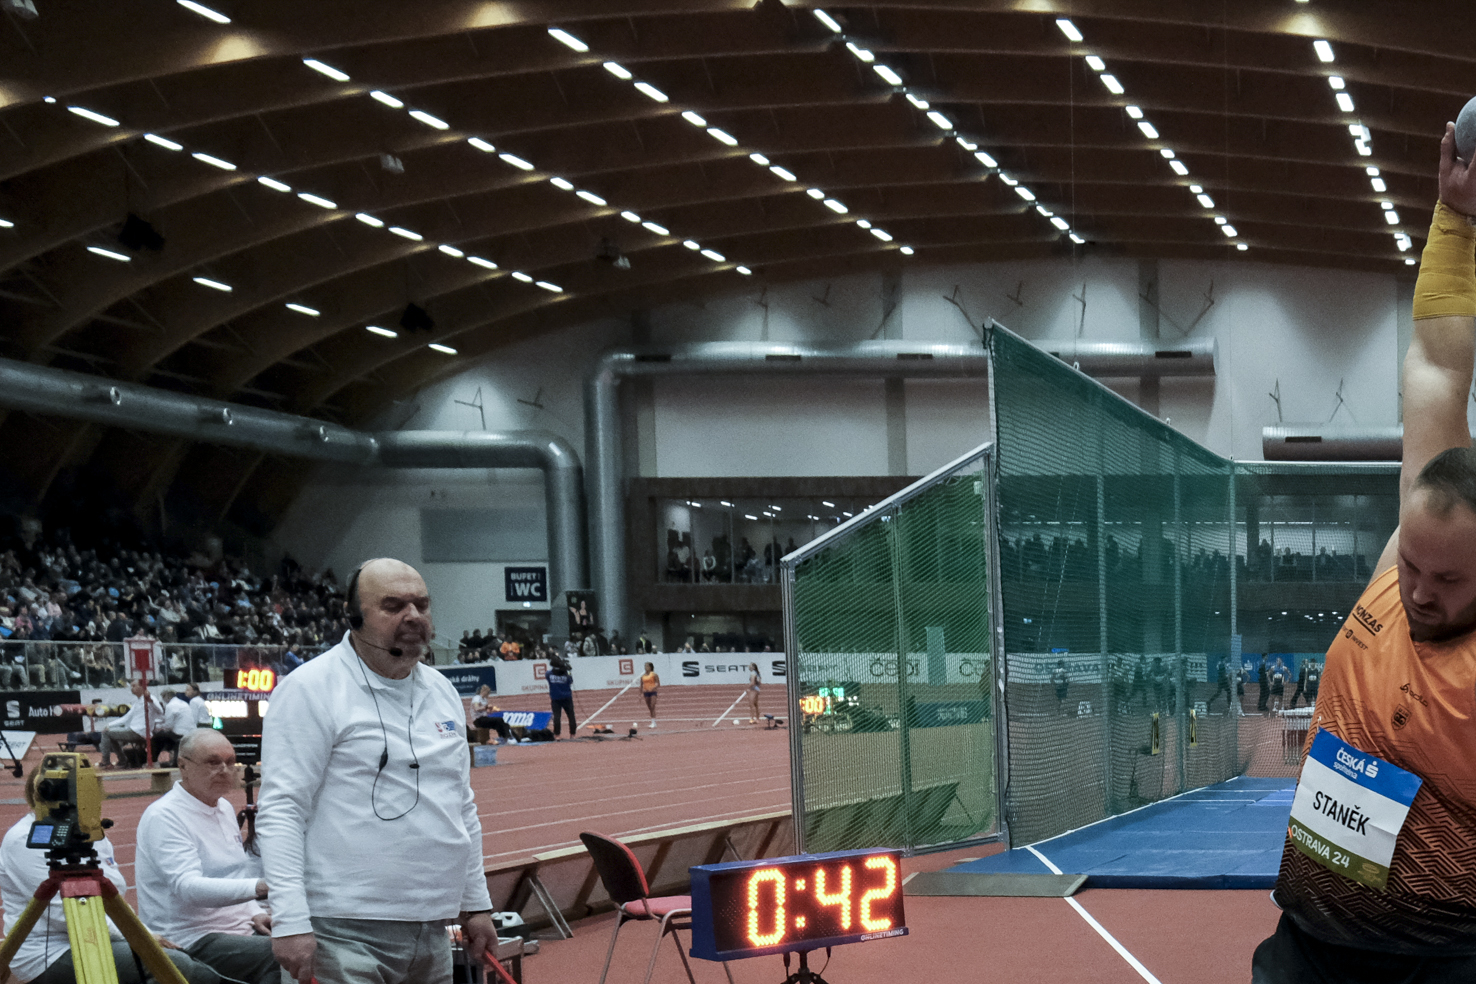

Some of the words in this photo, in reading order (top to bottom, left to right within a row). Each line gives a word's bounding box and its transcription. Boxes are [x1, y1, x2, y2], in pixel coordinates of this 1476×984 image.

[510, 572, 536, 581] BUFET
[514, 582, 541, 597] WC
[704, 664, 750, 673] SEAT
[236, 668, 275, 691] 1:00
[28, 705, 49, 718] Auto
[1336, 747, 1367, 774] ČESKÁ
[1312, 790, 1371, 836] STANĚK
[1290, 824, 1331, 860] OSTRAVA
[1331, 851, 1351, 869] 24
[747, 855, 897, 948] 0:42
[860, 928, 904, 942] ONLINETIMING
